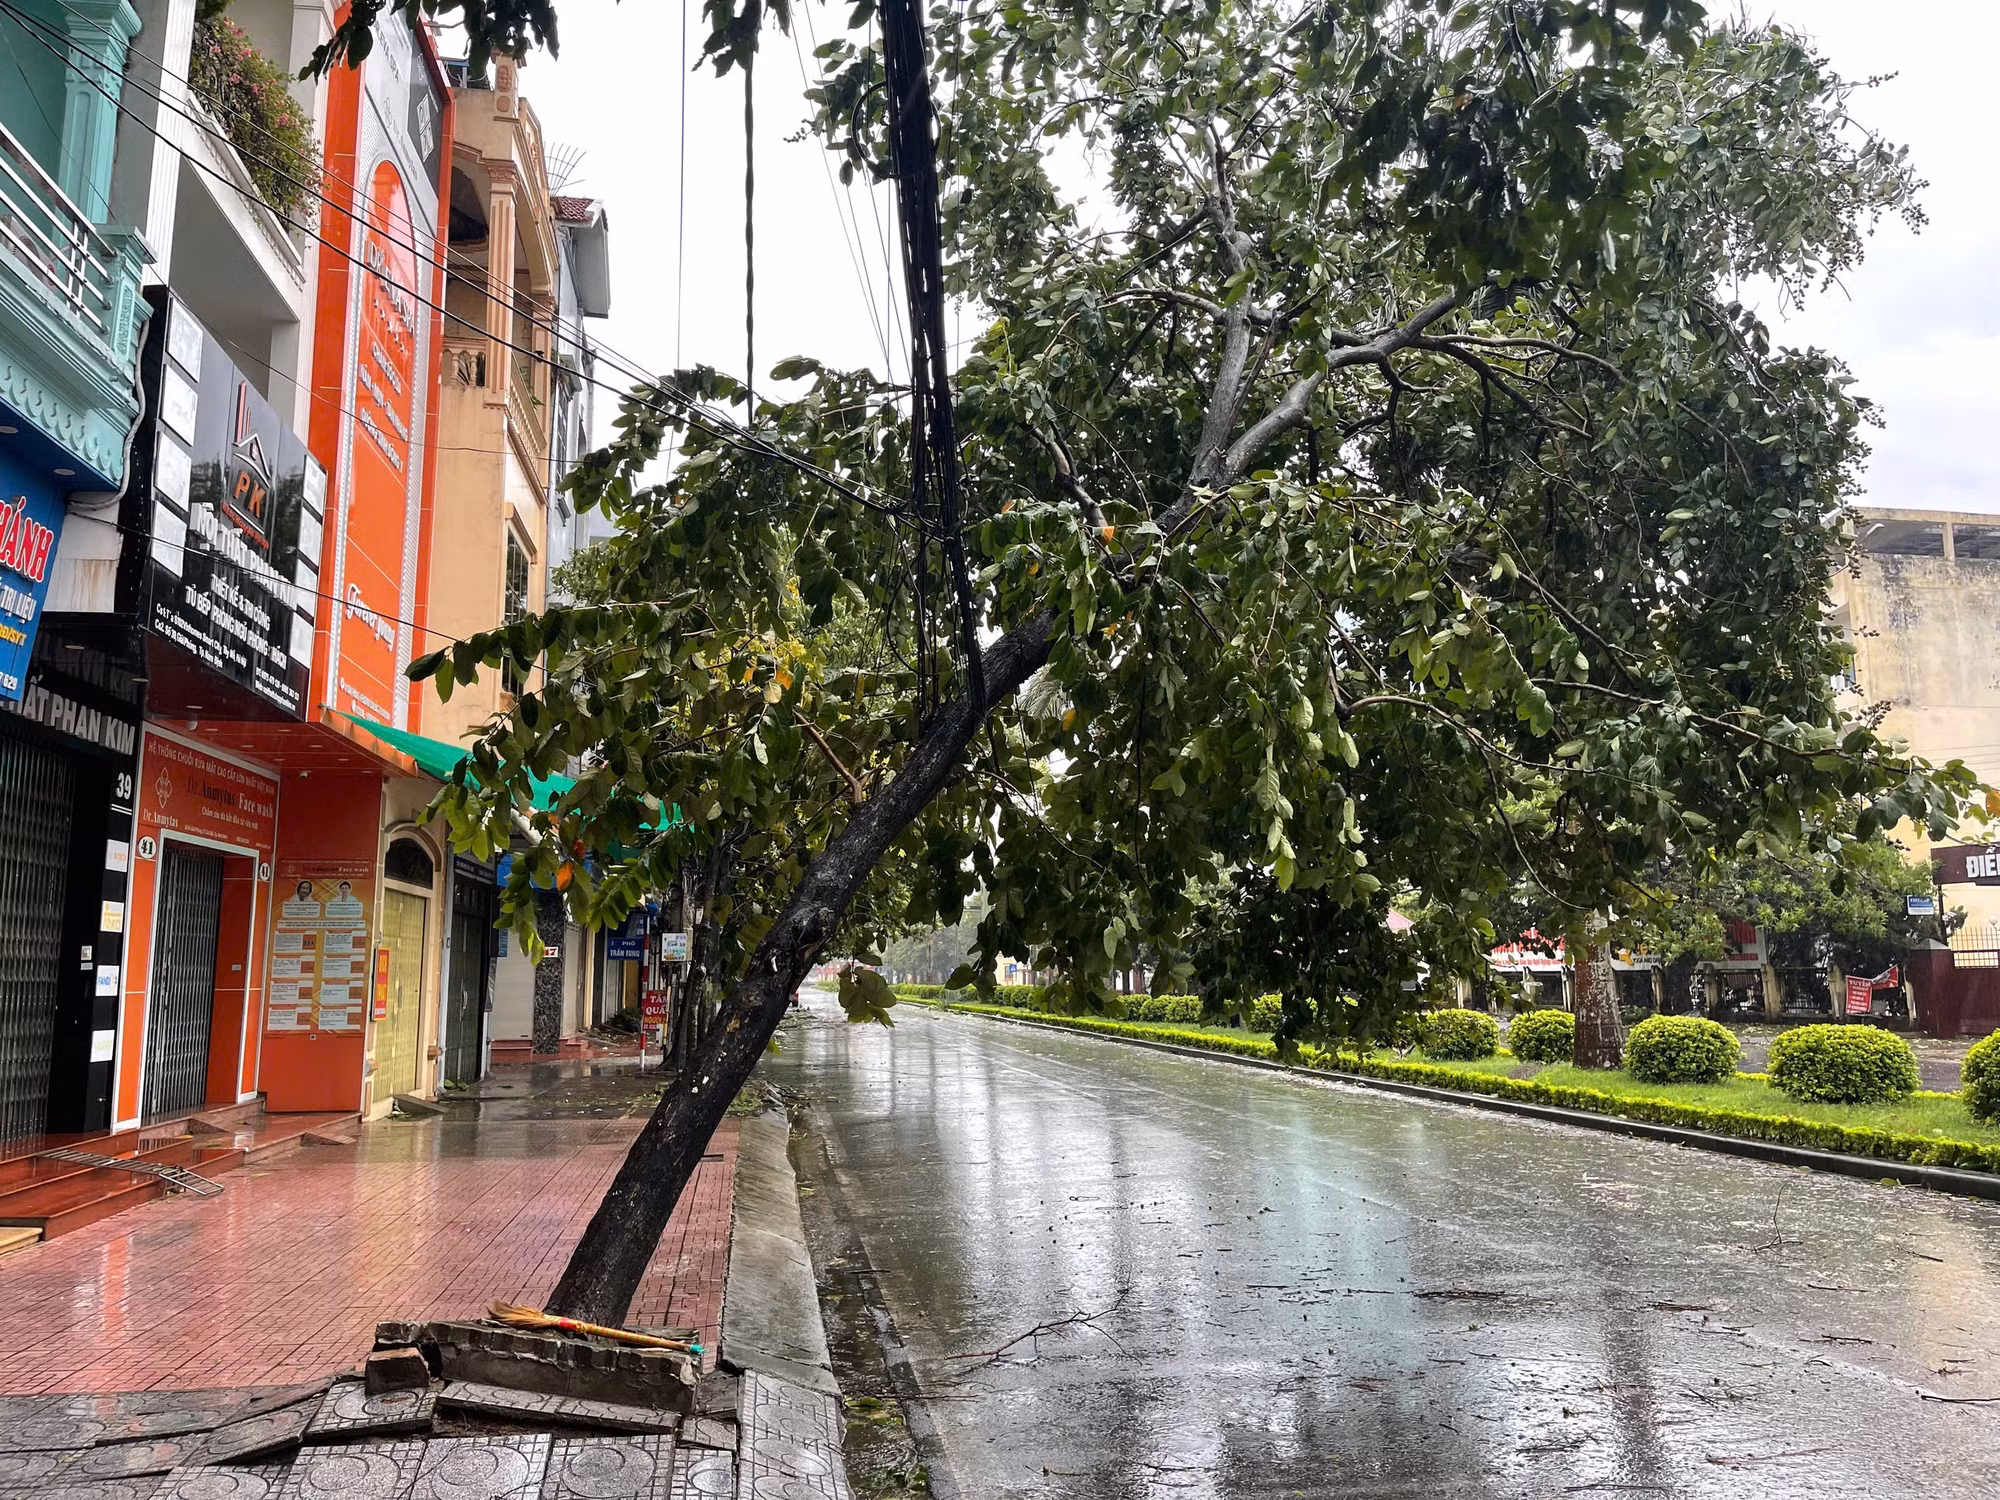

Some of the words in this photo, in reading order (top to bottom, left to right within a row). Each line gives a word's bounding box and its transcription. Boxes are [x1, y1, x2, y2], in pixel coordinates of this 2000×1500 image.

[233, 471, 266, 519] PK
[1, 584, 17, 618] TRỊ
[16, 591, 37, 624] LIỆU
[228, 585, 239, 608] KẾ
[238, 594, 244, 612] &
[253, 605, 270, 631] CÔNG
[185, 584, 197, 608] TỦ
[196, 591, 211, 616] BẾP
[210, 604, 235, 633] PHÒNG
[267, 645, 288, 670] HÁCH
[3, 676, 19, 691] 629
[0, 674, 49, 722] ẤT
[50, 693, 101, 743] PHAN
[104, 715, 135, 756] KIM
[148, 740, 157, 756] HỆ
[158, 743, 177, 760] THỐNG
[177, 750, 193, 767] CHUỖI
[216, 766, 227, 779] CAO
[116, 772, 132, 800] 39
[238, 792, 256, 814] Face
[256, 803, 273, 819] wash
[141, 839, 153, 855] 41
[260, 865, 269, 878] 41
